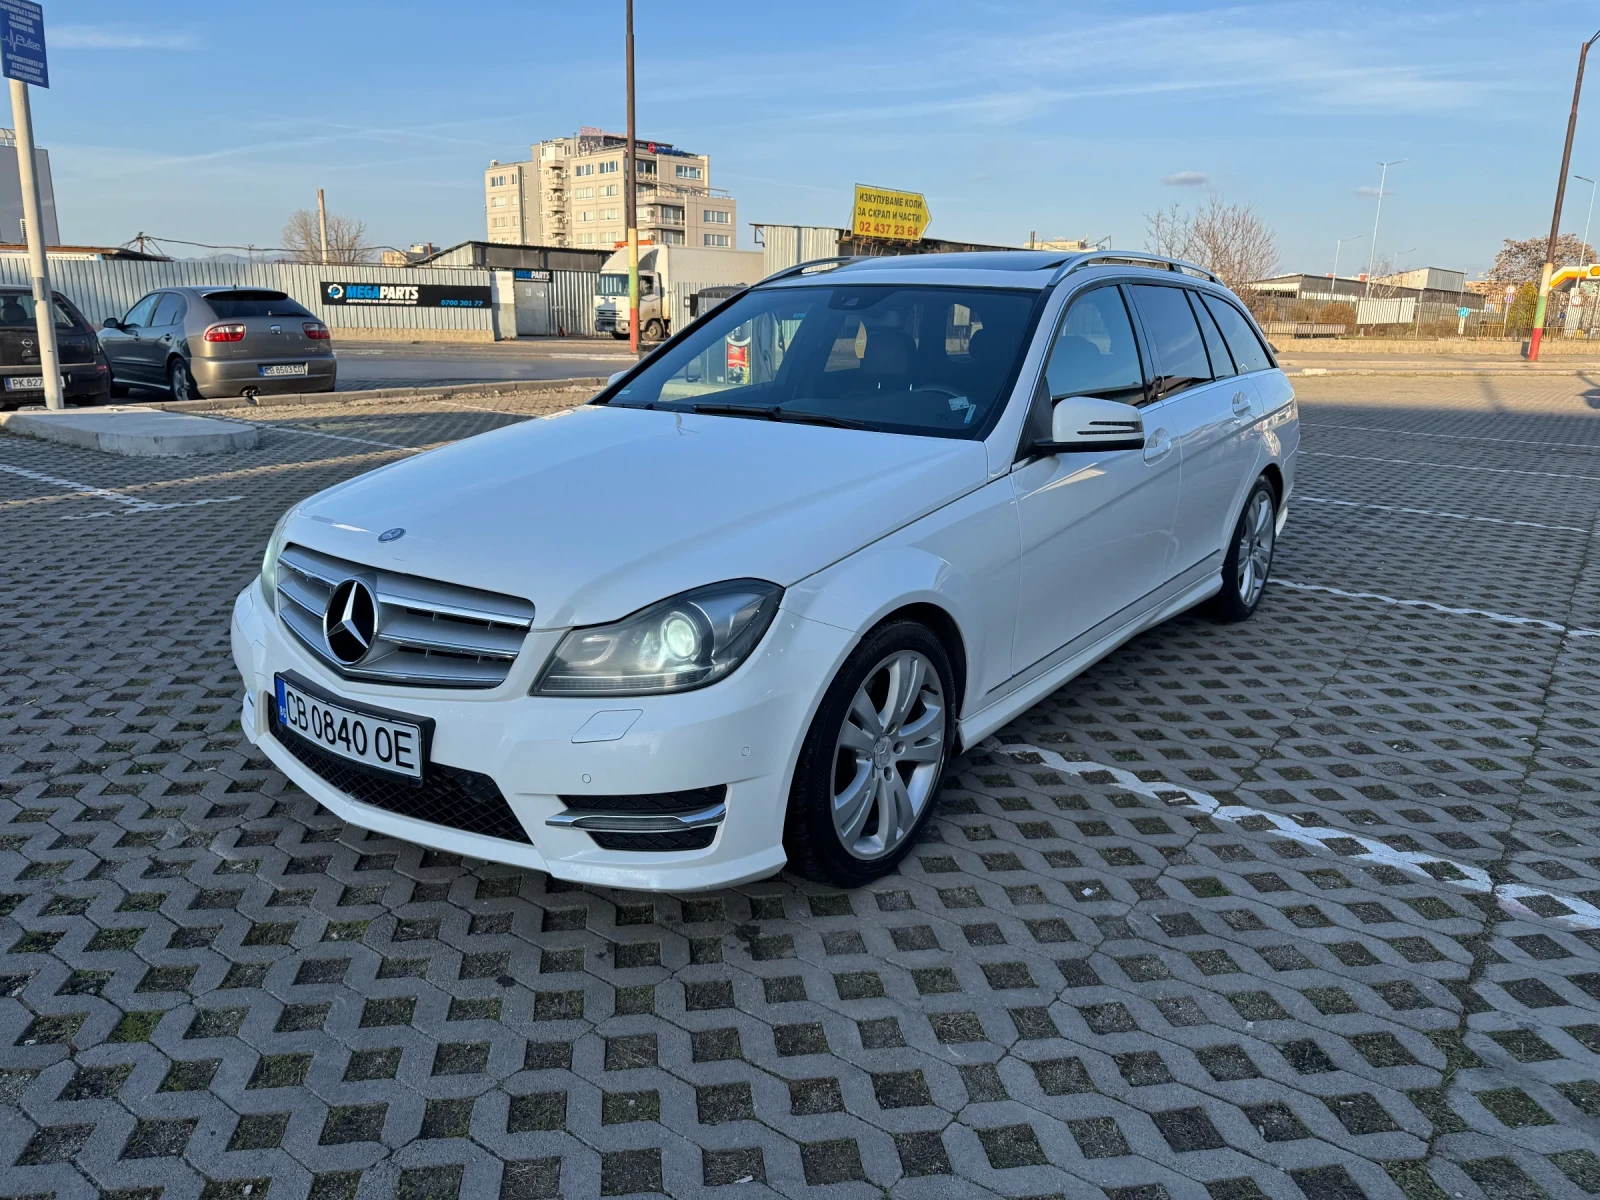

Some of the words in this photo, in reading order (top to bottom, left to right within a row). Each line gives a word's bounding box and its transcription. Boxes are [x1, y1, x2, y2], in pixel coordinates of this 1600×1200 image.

[16, 34, 41, 50] Pulse
[859, 192, 903, 207] ИЗКУПУВАМЕ
[904, 199, 922, 209] КОЛИ
[857, 207, 866, 216] ЗА
[868, 208, 891, 219] СКРАП
[892, 211, 897, 219] И
[899, 212, 922, 223] ЧАСТИ!
[859, 221, 871, 232] 02
[874, 222, 891, 234] 437
[894, 225, 905, 236] 23
[907, 226, 918, 237] 64
[516, 270, 550, 279] MEGAPARTS
[346, 285, 419, 300] MEGAPARTS
[26, 378, 44, 387] 827
[286, 690, 309, 731] CB
[311, 704, 368, 756] 0840
[374, 726, 415, 770] OE
